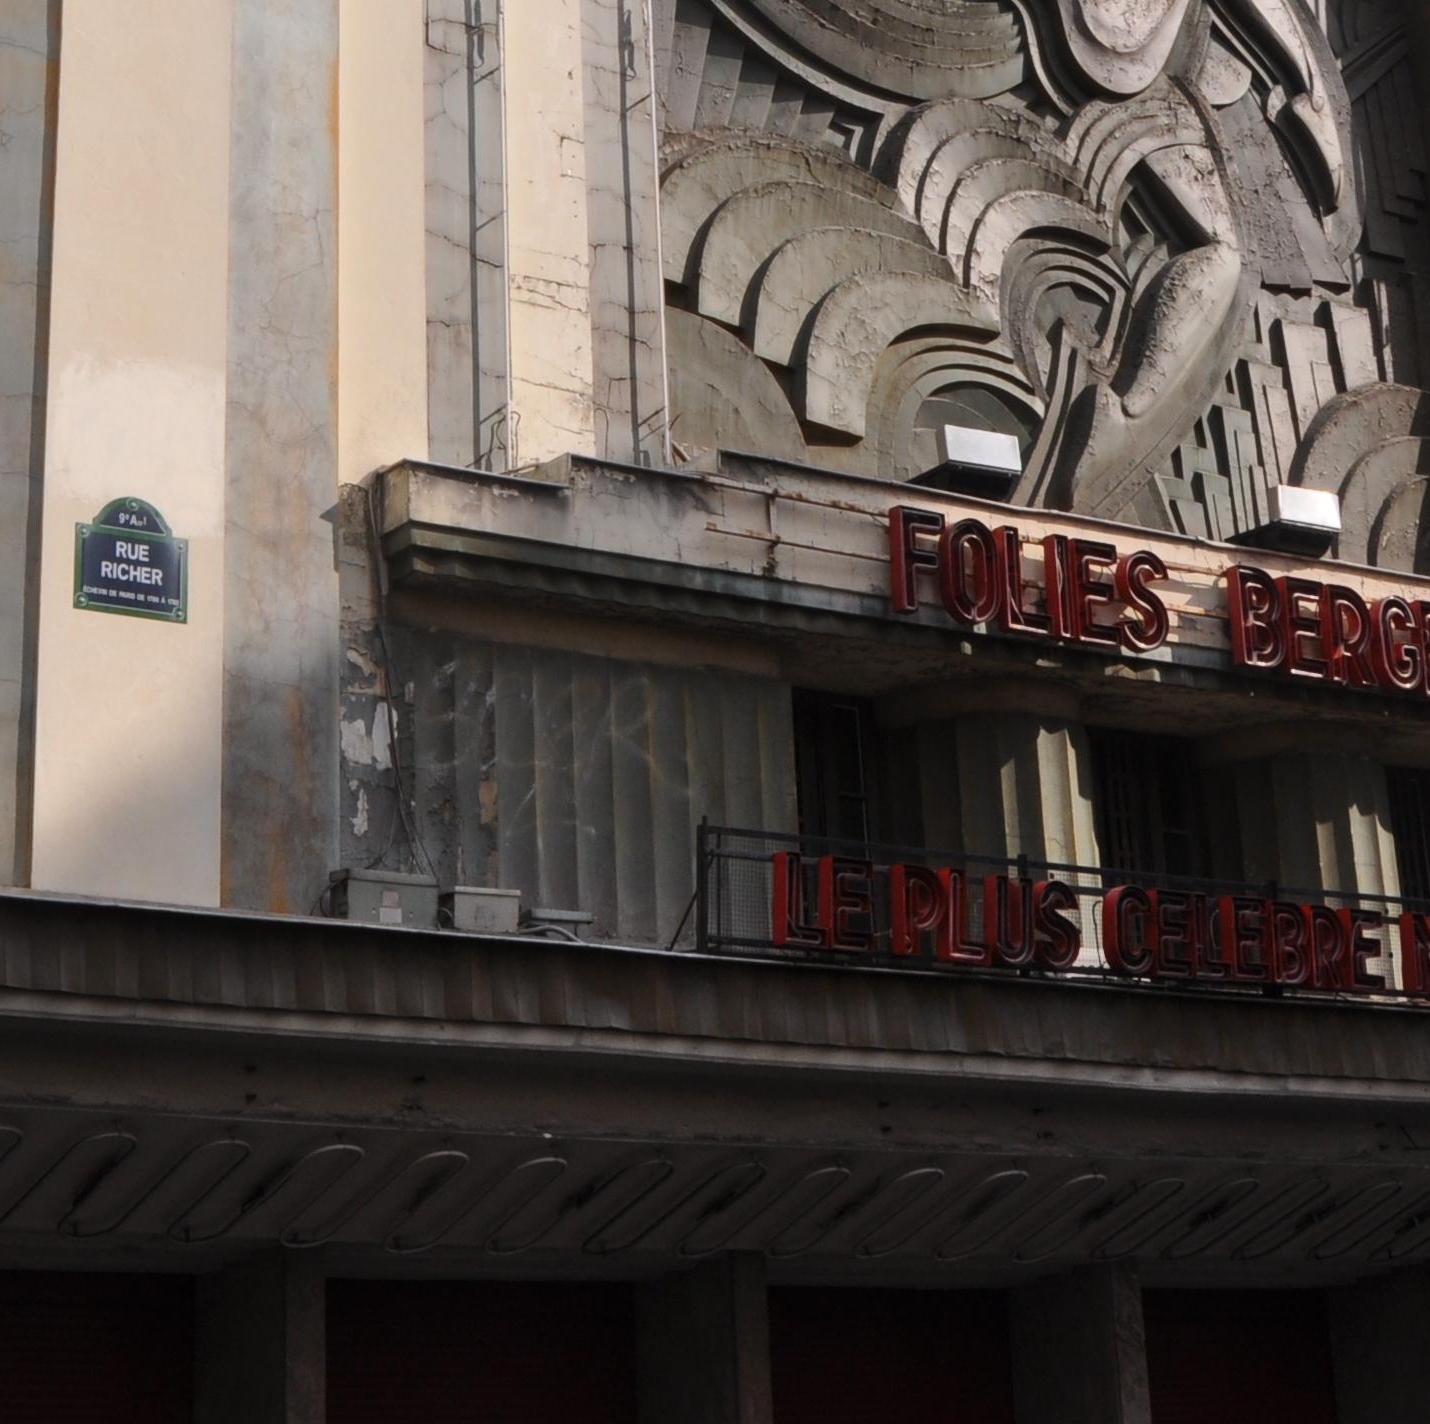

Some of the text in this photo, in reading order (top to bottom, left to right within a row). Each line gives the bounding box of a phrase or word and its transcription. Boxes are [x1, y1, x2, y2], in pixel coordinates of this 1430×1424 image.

[100, 561, 163, 586] RICHER
[115, 541, 150, 562] RUE
[889, 504, 1170, 653] FOLIES
[773, 851, 874, 953] LE
[890, 863, 1081, 970] PLUS
[1102, 883, 1386, 991] CELEBRE
